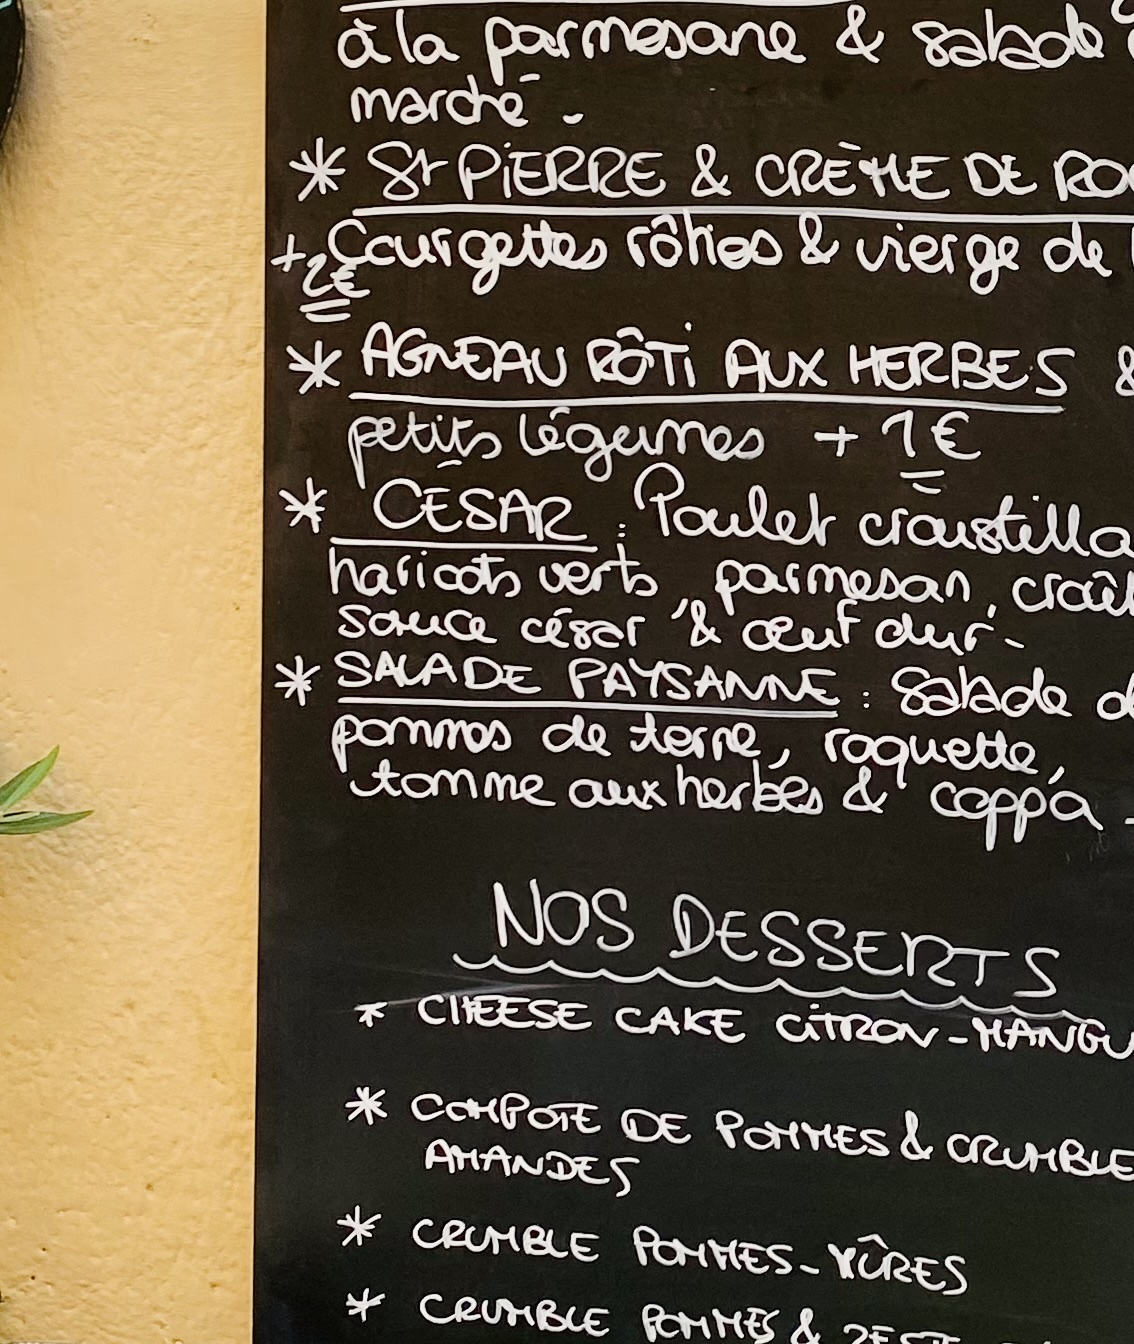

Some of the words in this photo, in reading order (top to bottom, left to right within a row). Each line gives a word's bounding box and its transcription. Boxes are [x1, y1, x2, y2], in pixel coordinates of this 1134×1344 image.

[338, 18, 392, 69] à
[396, 9, 460, 63] la
[485, 16, 807, 85] parmesane
[836, 3, 884, 63] &
[911, 2, 1105, 70] salade
[350, 74, 541, 128] marché
[690, 143, 731, 197] &
[963, 152, 1038, 198] DE
[328, 218, 608, 295] Courgettes
[627, 208, 784, 270] rôties
[798, 211, 839, 265] &
[856, 222, 1020, 295] vierge
[1042, 216, 1113, 278] de
[361, 321, 567, 387] AGNEAU
[725, 338, 827, 393] AUX
[849, 340, 1075, 397] HERBES
[346, 410, 502, 488] petits
[519, 406, 765, 483] légumes
[633, 462, 837, 546] Poulet
[329, 546, 522, 598] haricots
[336, 604, 498, 646] sauce
[520, 607, 645, 649] césar
[688, 598, 723, 647] &
[334, 650, 543, 694] SALADE
[566, 657, 841, 706] PAYSANNE
[331, 712, 513, 774] pommes
[541, 714, 613, 757] de
[348, 758, 557, 808] tomme
[567, 771, 668, 811] aux
[842, 766, 888, 815] &
[929, 780, 1104, 852] coppa
[493, 878, 636, 953] NOS
[669, 892, 1061, 999] DESSERTS
[416, 994, 593, 1031] CHEESE
[614, 1006, 746, 1044] CAKE
[409, 1092, 601, 1135] COMPOTE
[620, 1108, 692, 1144] DE
[715, 1109, 891, 1158] POMMES
[899, 1110, 934, 1160] &
[424, 1138, 641, 1198] AMANDES
[411, 1218, 600, 1263] CRUMBLE
[418, 1293, 610, 1337] CRUMBLE
[641, 1302, 780, 1344] POMMES
